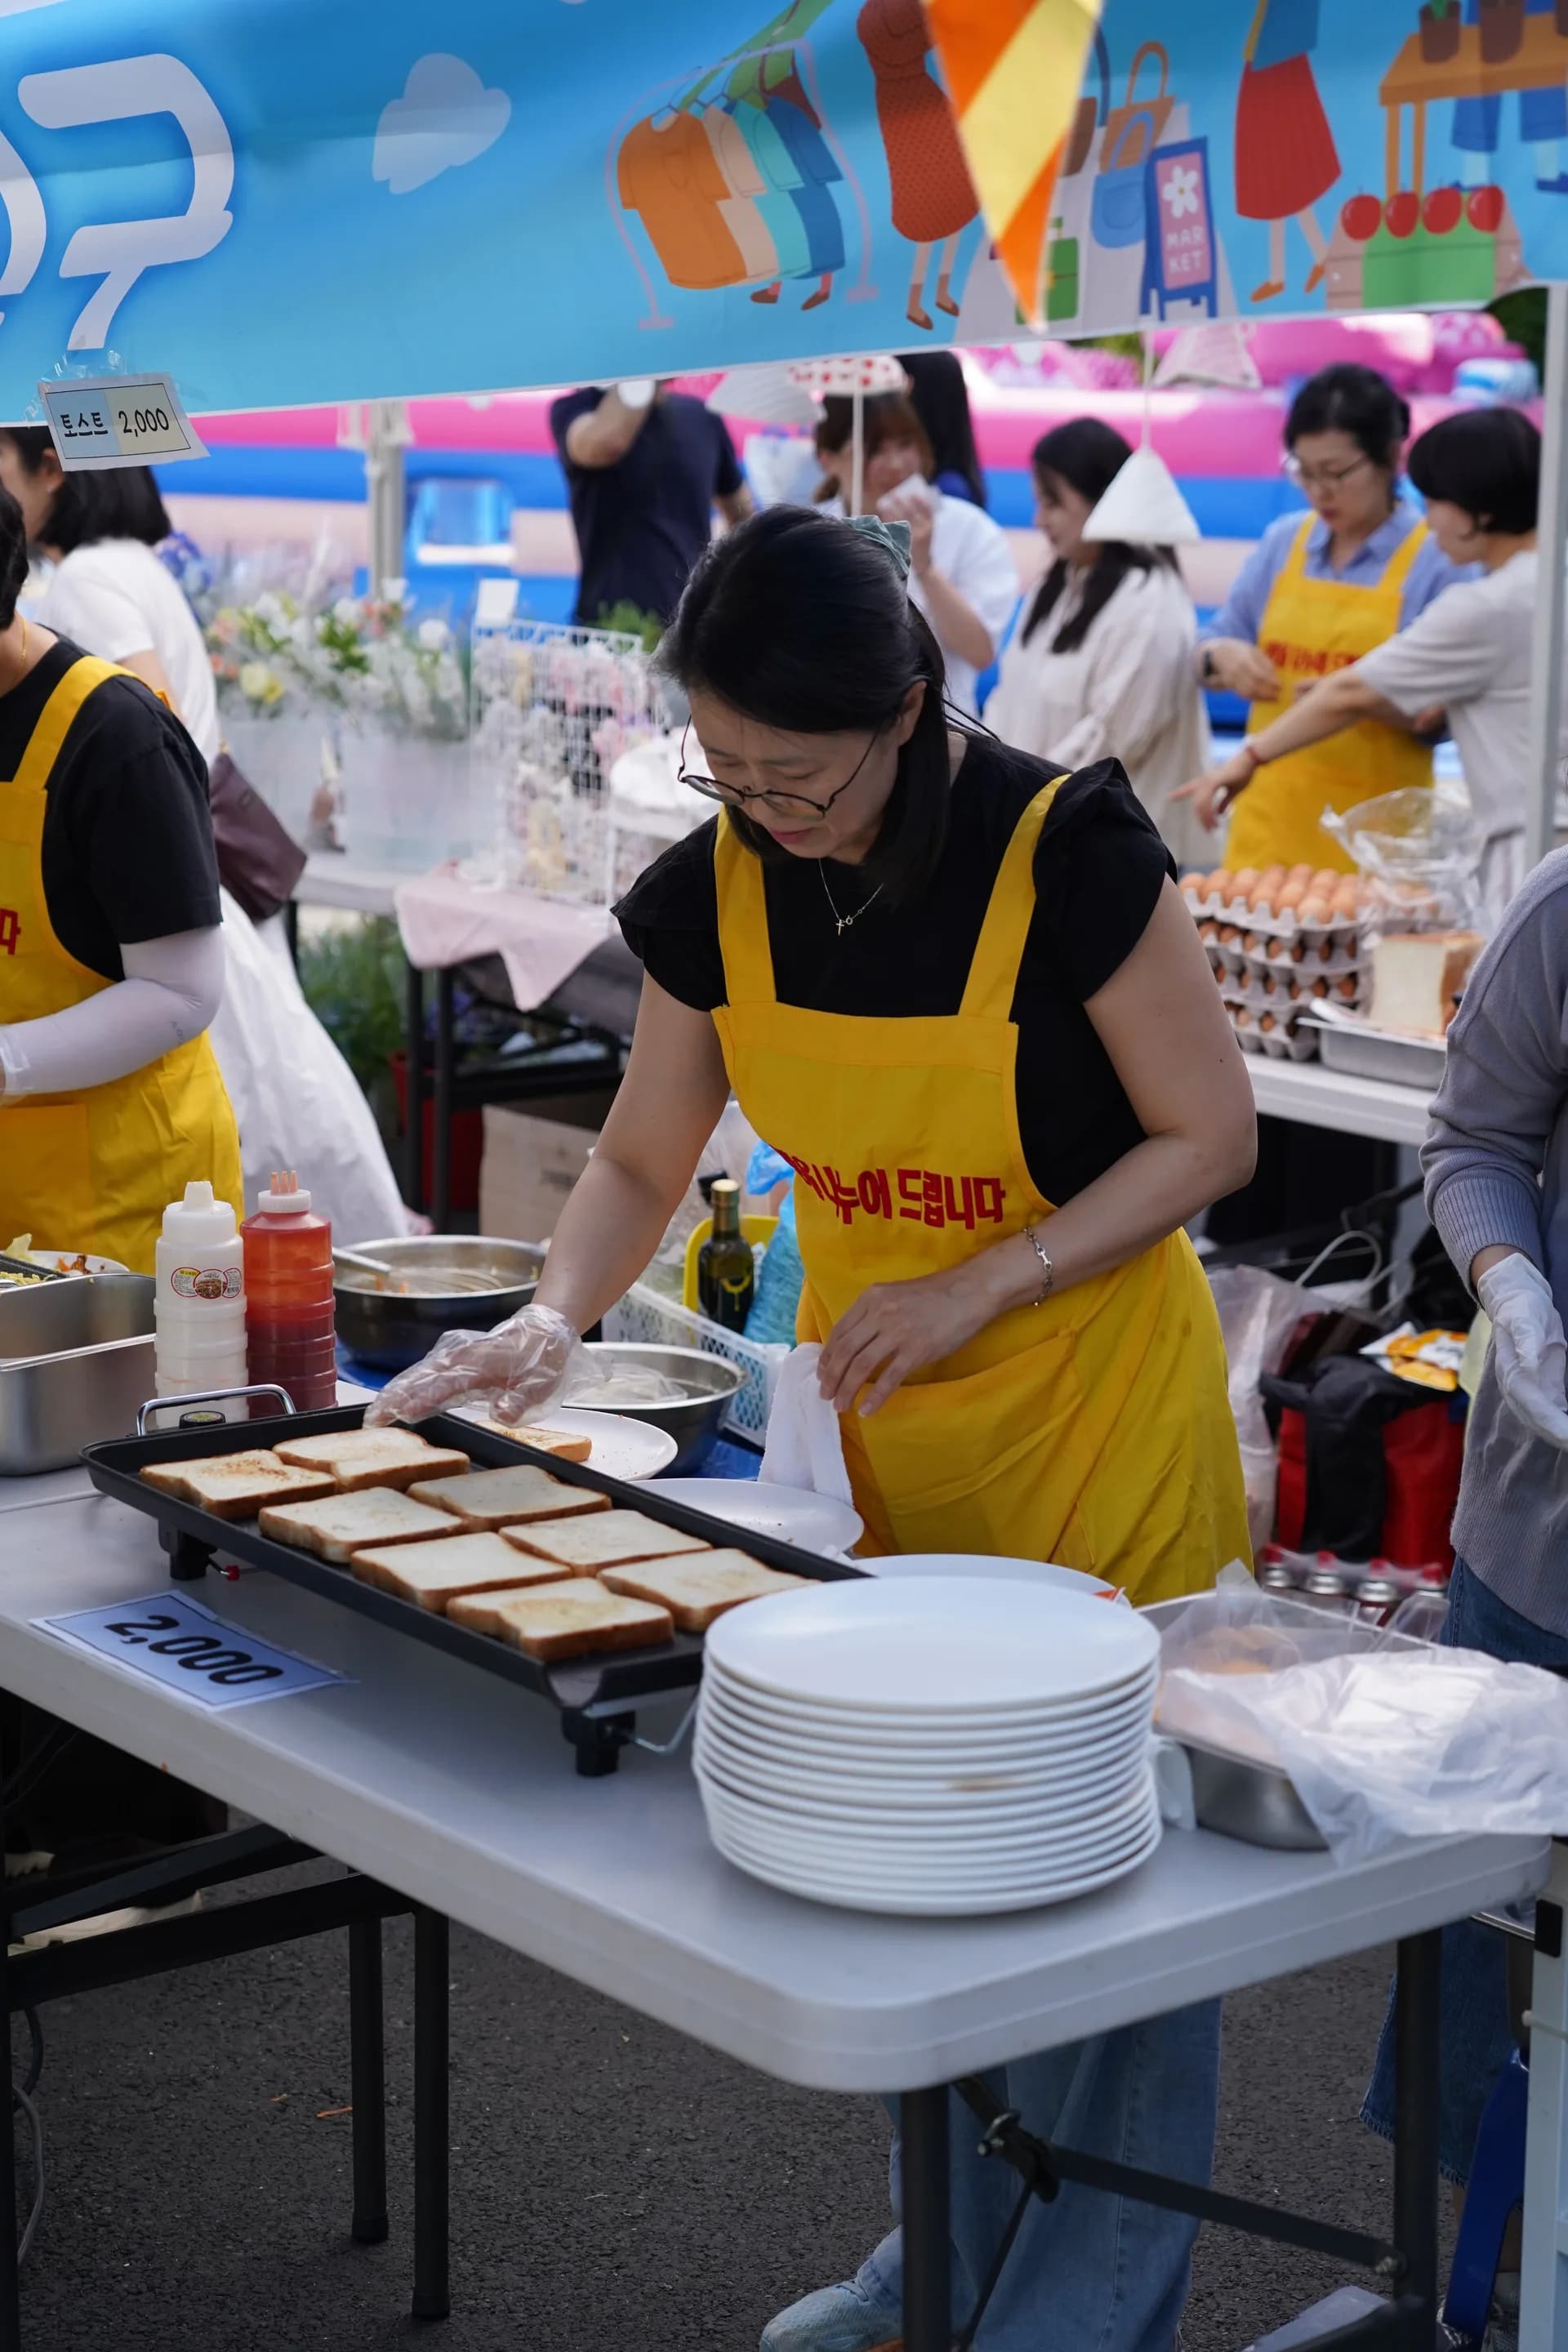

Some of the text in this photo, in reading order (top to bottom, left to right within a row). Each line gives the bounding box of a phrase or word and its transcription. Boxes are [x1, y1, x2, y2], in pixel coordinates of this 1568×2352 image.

[0, 53, 234, 350] 구
[1165, 225, 1204, 248] MAR
[1169, 249, 1204, 273] KET
[60, 408, 169, 438] 토스트 2,000
[104, 1615, 284, 1685] 2,000
